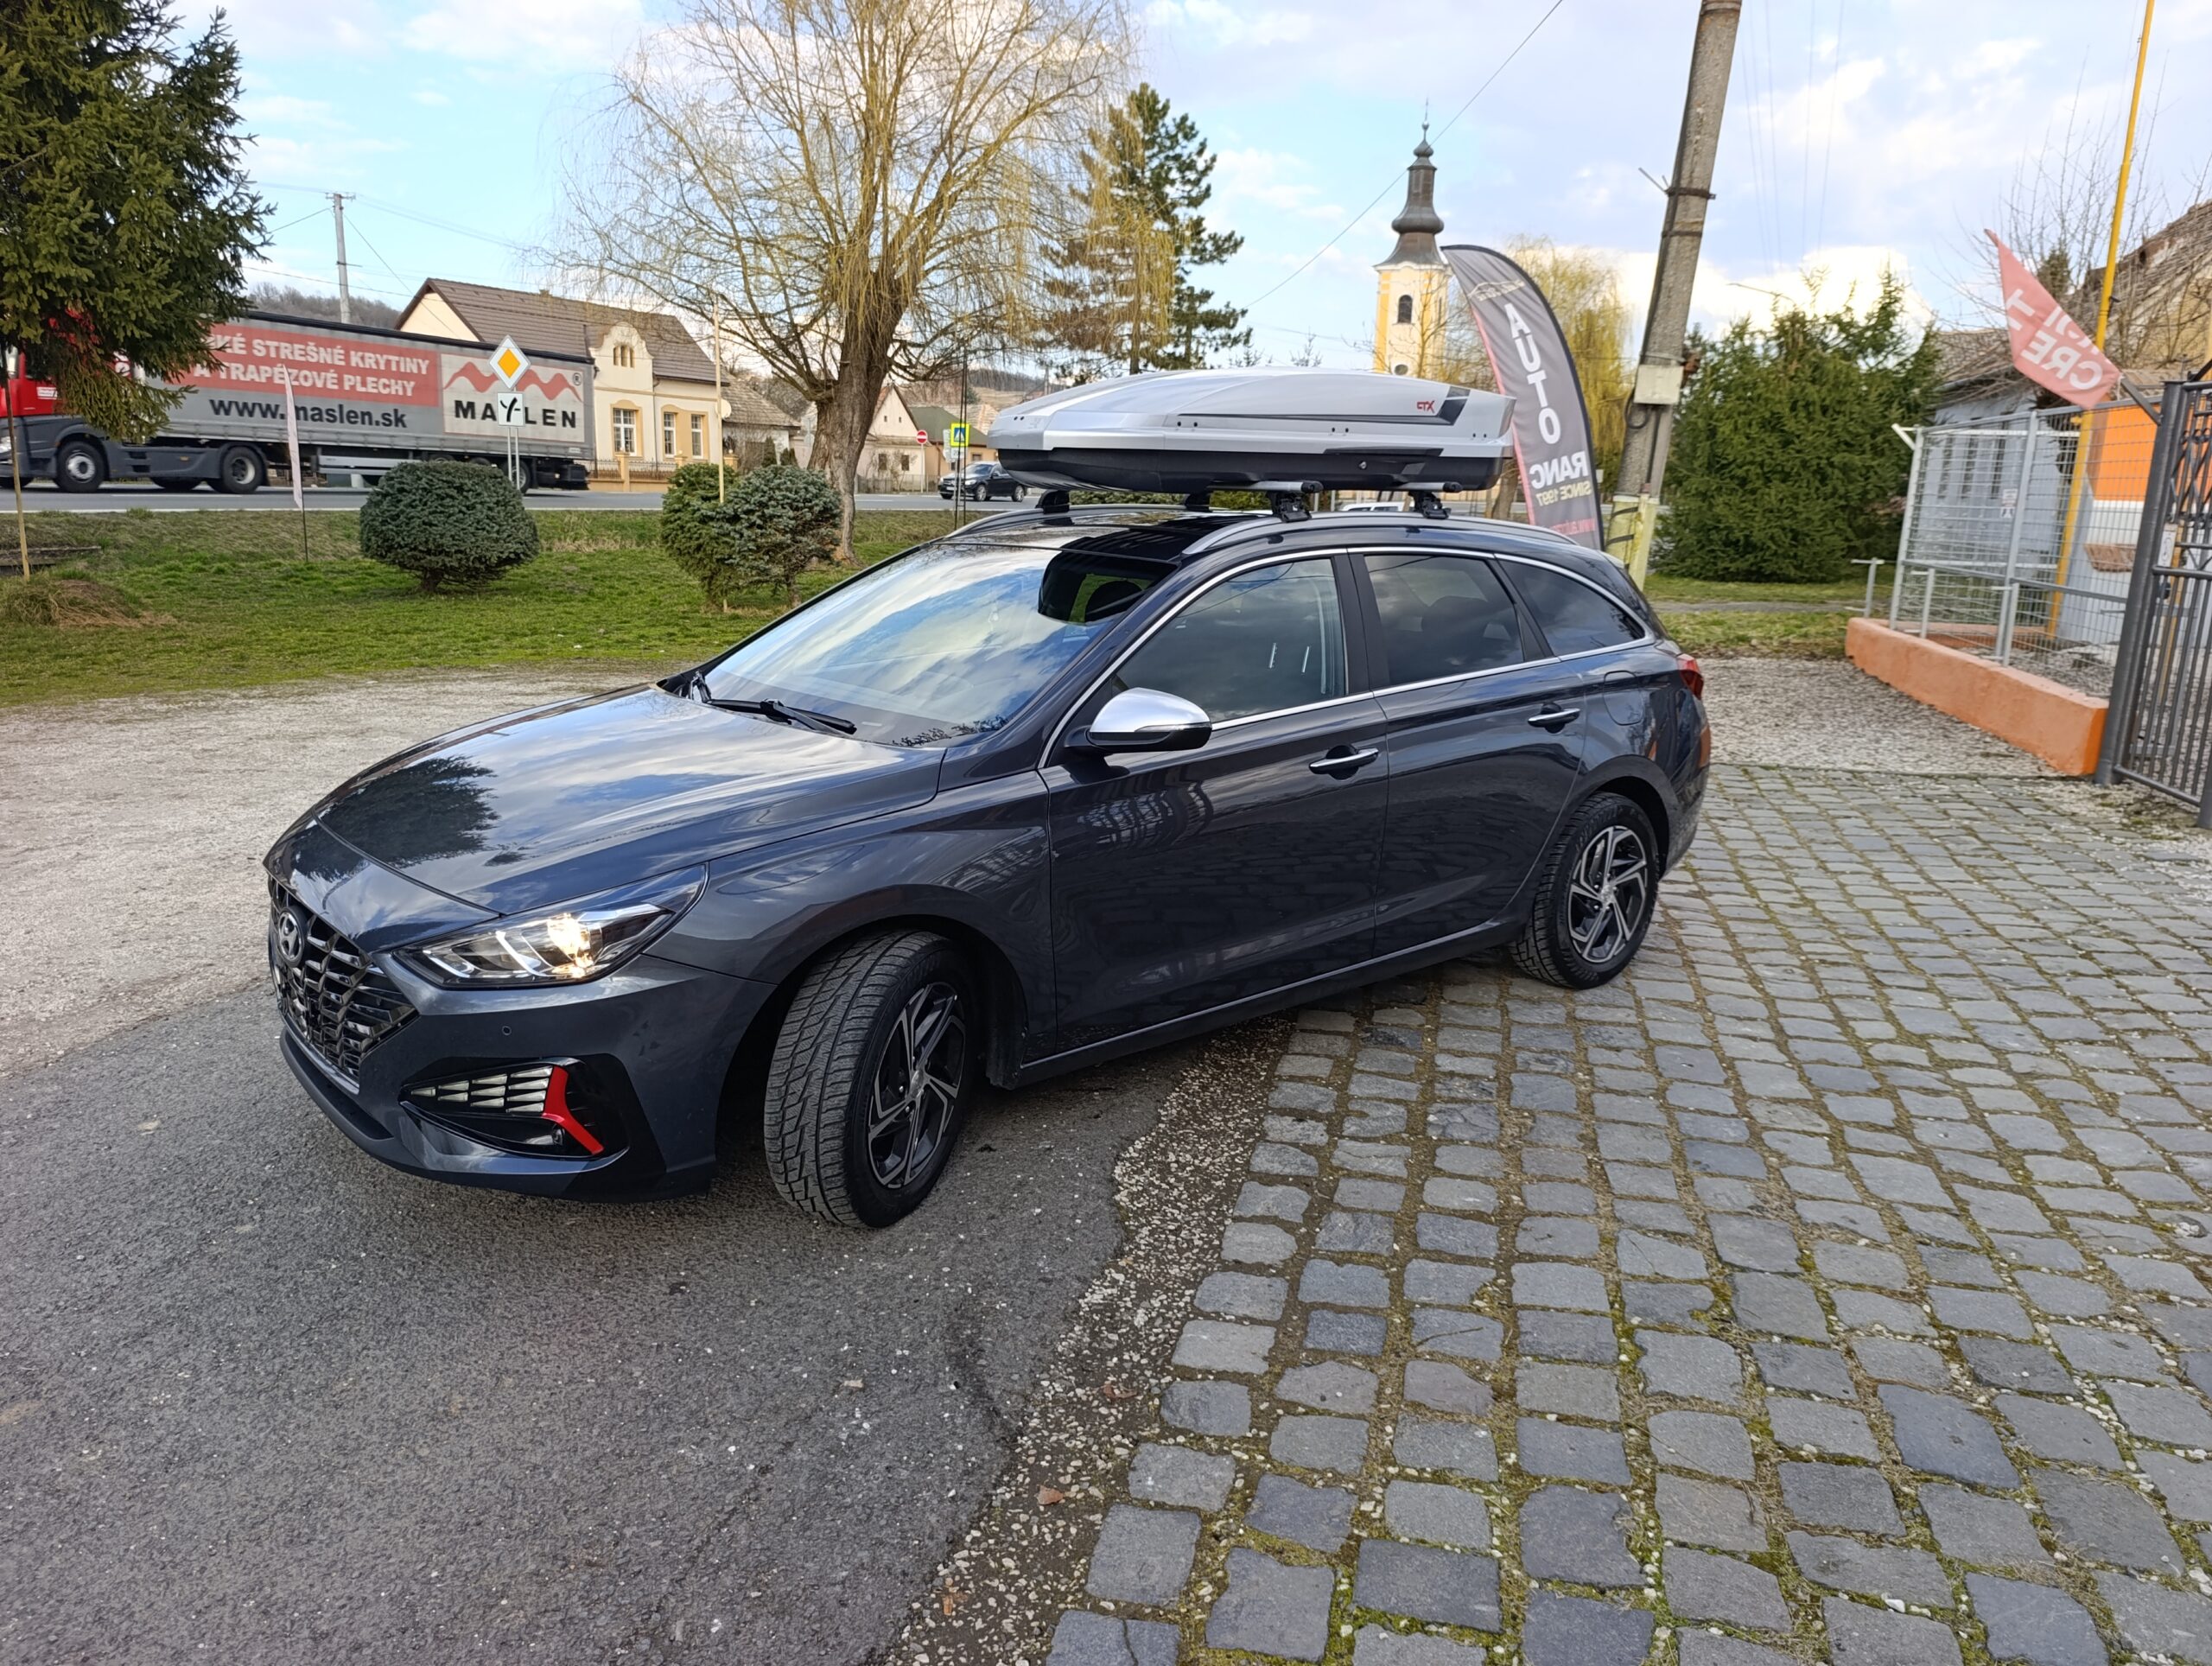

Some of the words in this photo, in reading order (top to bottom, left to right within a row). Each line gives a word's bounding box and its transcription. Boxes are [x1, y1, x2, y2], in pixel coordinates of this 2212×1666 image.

[252, 338, 346, 366] STREŠNÉ
[350, 350, 430, 375] KRYTINY
[343, 373, 416, 397] PLECHY
[1504, 303, 1561, 445] AUTO
[454, 399, 576, 429] MALEN
